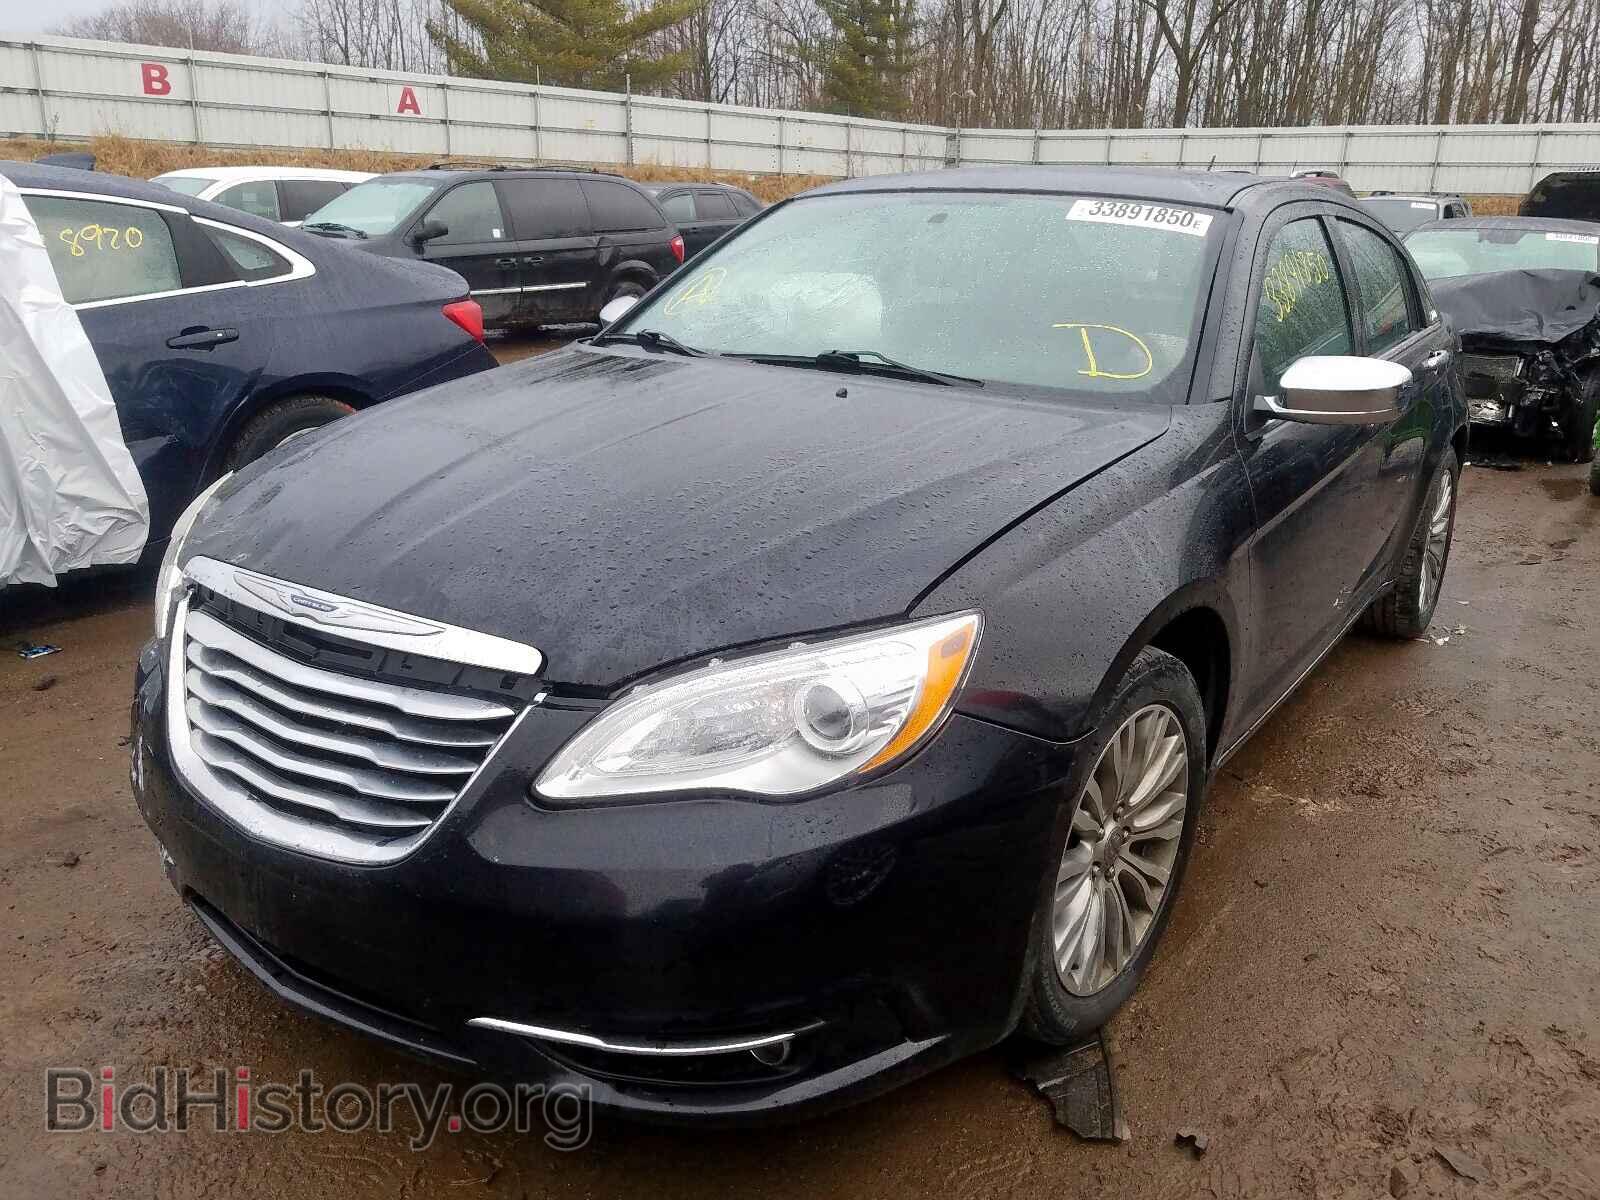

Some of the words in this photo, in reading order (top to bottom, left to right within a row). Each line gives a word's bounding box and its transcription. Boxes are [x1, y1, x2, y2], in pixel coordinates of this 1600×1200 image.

[140, 63, 172, 96] B
[397, 87, 421, 115] A
[1052, 323, 1152, 379] D
